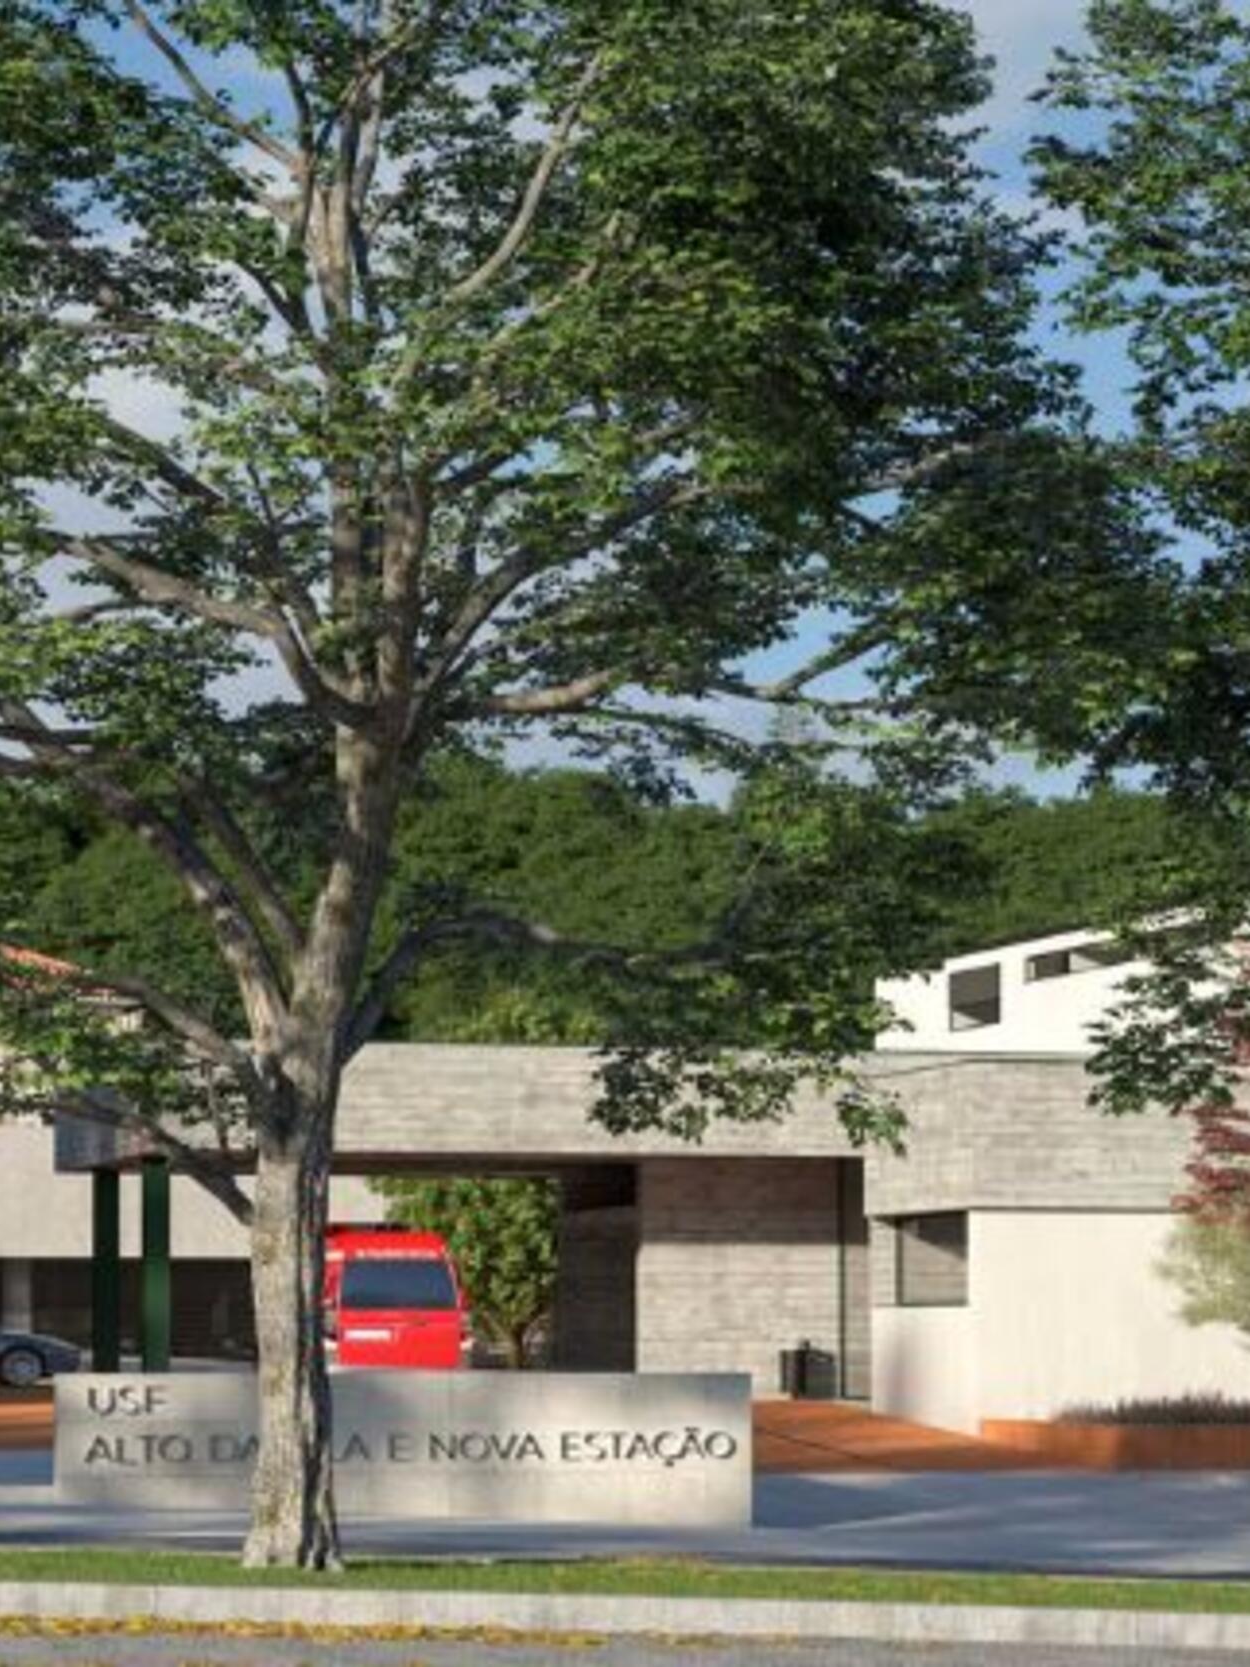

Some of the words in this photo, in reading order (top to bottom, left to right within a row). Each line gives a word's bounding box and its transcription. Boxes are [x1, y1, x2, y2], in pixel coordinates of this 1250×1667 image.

[87, 1385, 170, 1417] USF
[84, 1434, 192, 1466] ALTO
[388, 1433, 413, 1463] E
[429, 1431, 545, 1461] NOVA
[560, 1427, 738, 1467] ESTAÇÃO
